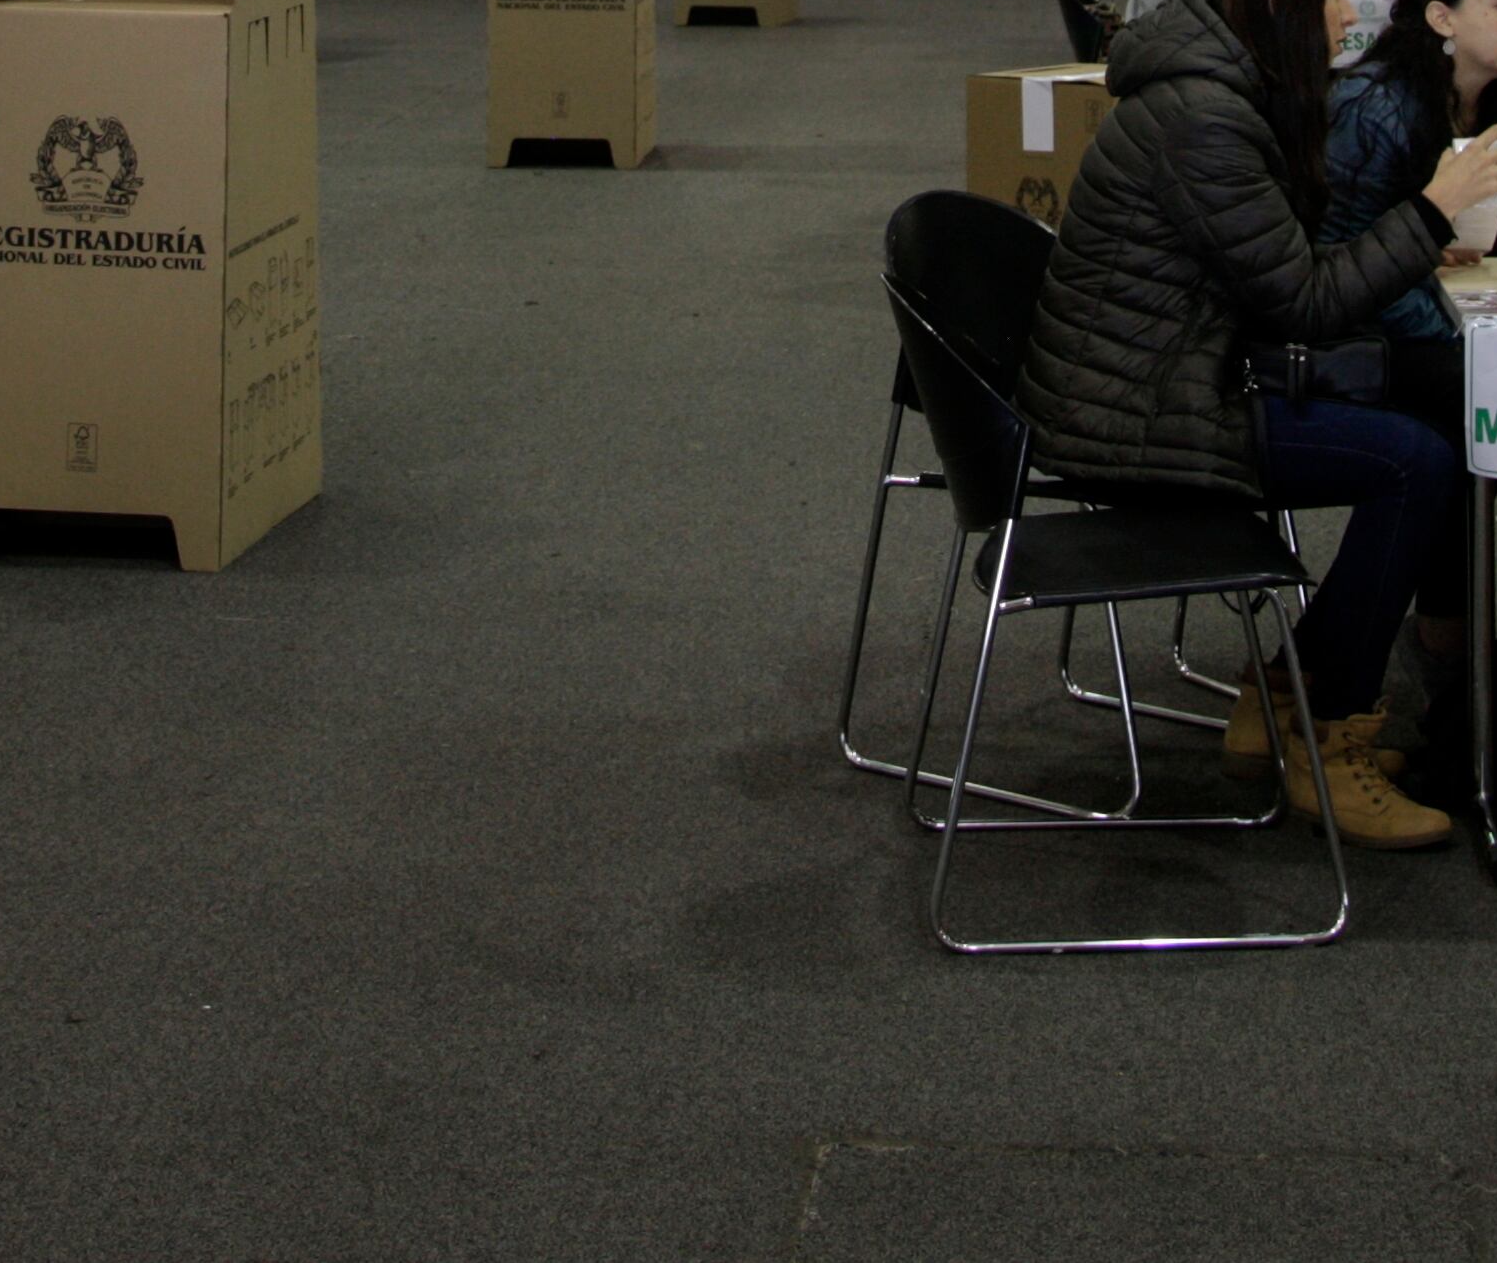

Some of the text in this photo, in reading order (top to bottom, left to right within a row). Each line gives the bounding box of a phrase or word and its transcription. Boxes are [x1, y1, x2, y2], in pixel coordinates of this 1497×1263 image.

[53, 252, 87, 267] DEL
[91, 254, 157, 269] ESTADO
[162, 256, 206, 271] CIVIL
